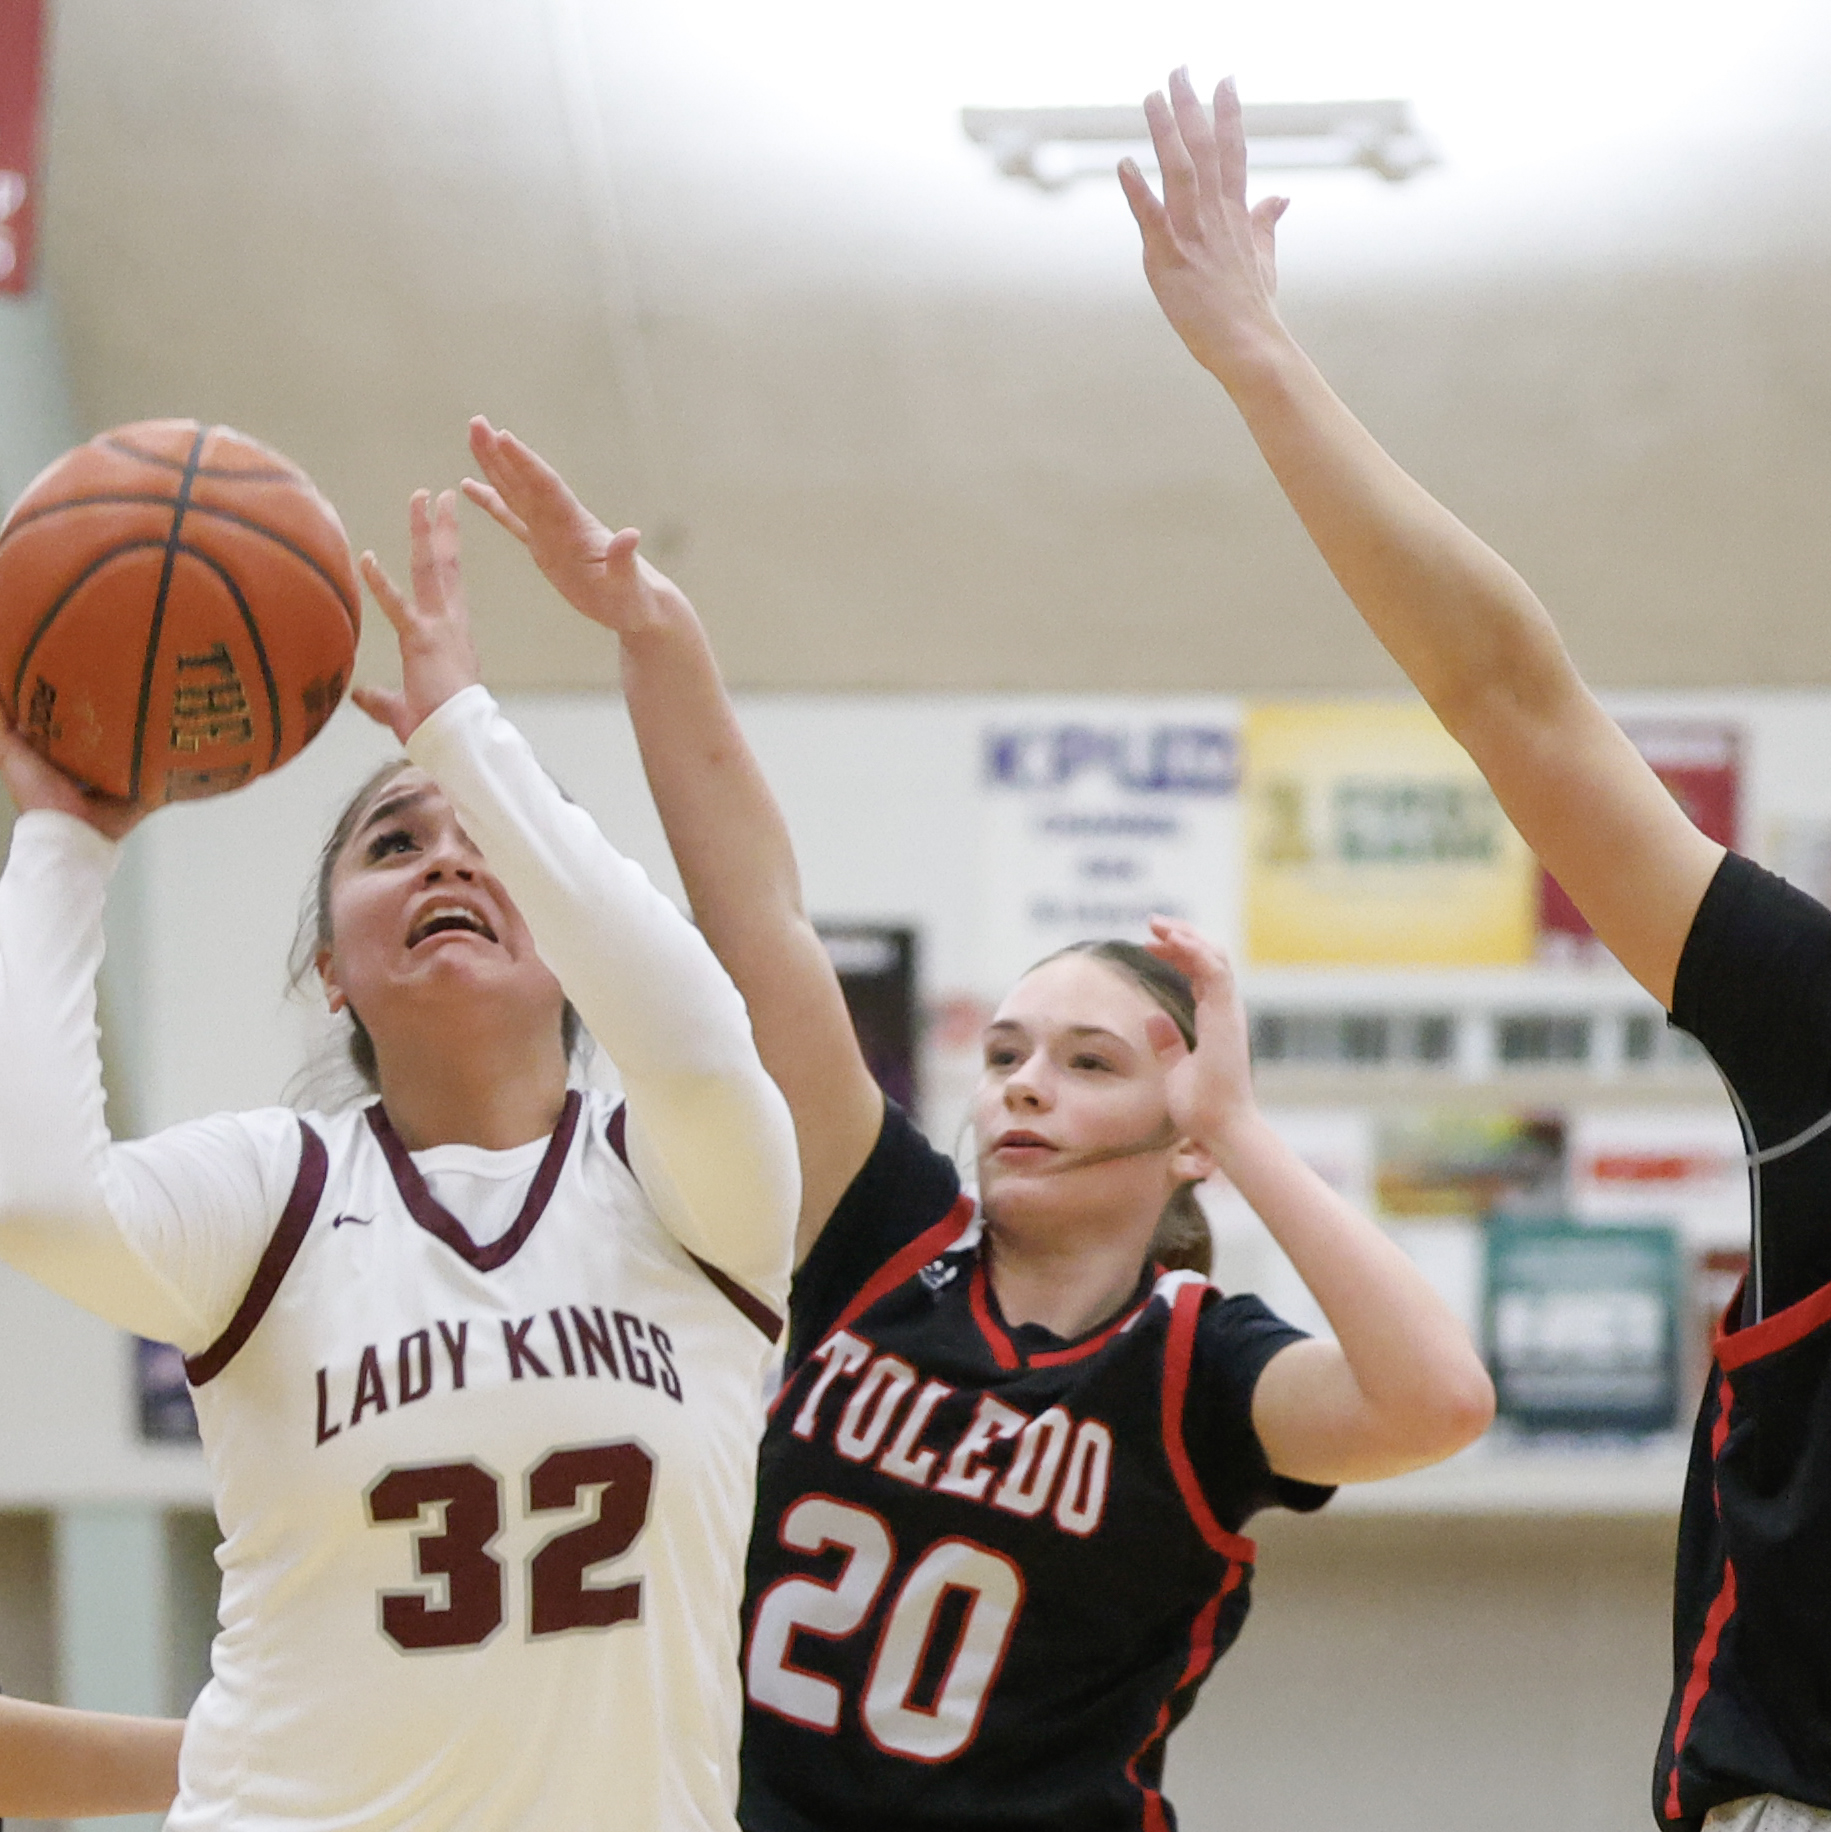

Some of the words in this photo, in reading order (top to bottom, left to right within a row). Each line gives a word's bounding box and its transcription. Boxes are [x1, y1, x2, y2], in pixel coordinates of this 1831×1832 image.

[315, 1319, 470, 1449] LADY
[500, 1304, 685, 1406] KINGS
[790, 1329, 1113, 1538] TOLEDO
[362, 1433, 661, 1658] 32
[748, 1491, 1027, 1765] 20
